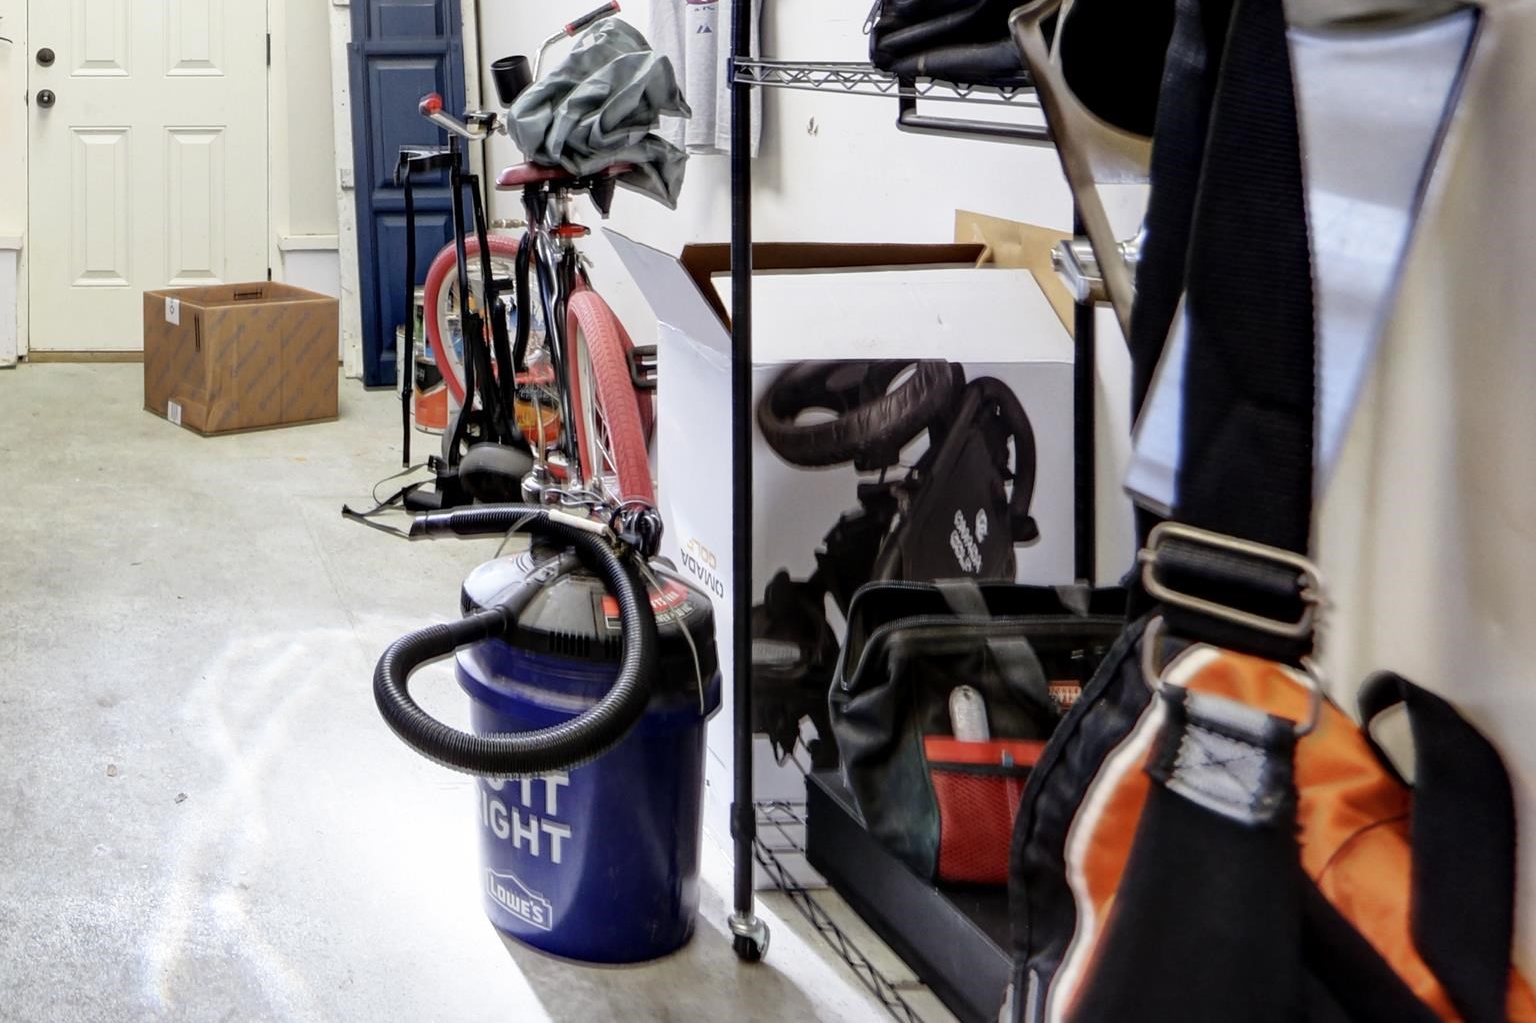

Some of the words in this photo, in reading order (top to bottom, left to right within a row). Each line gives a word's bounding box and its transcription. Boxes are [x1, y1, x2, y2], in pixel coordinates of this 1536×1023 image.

[680, 547, 724, 599] OMADA
[482, 790, 571, 864] IGHT
[490, 875, 543, 923] LOWE'S
